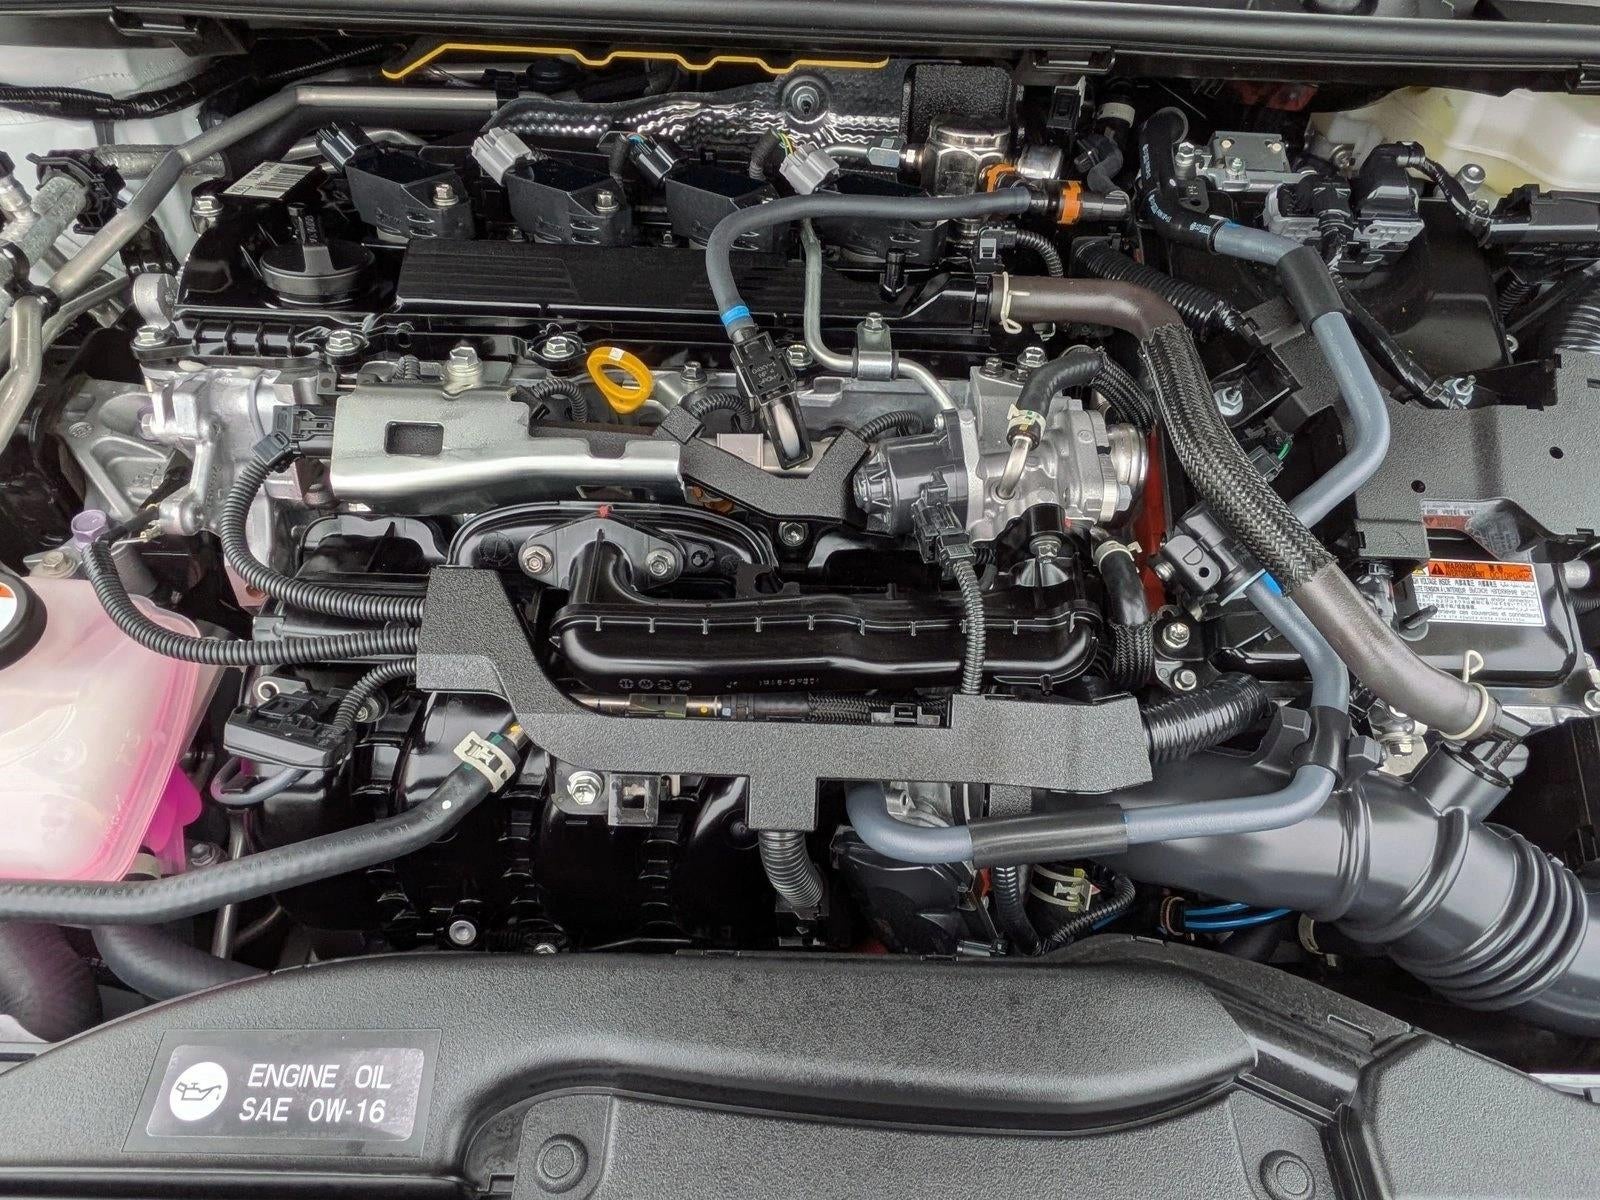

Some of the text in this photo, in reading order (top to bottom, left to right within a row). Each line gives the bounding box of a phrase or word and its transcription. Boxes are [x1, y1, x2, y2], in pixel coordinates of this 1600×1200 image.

[247, 1063, 392, 1089] ENGINE OIL
[238, 1097, 386, 1123] SAE 0W-16
